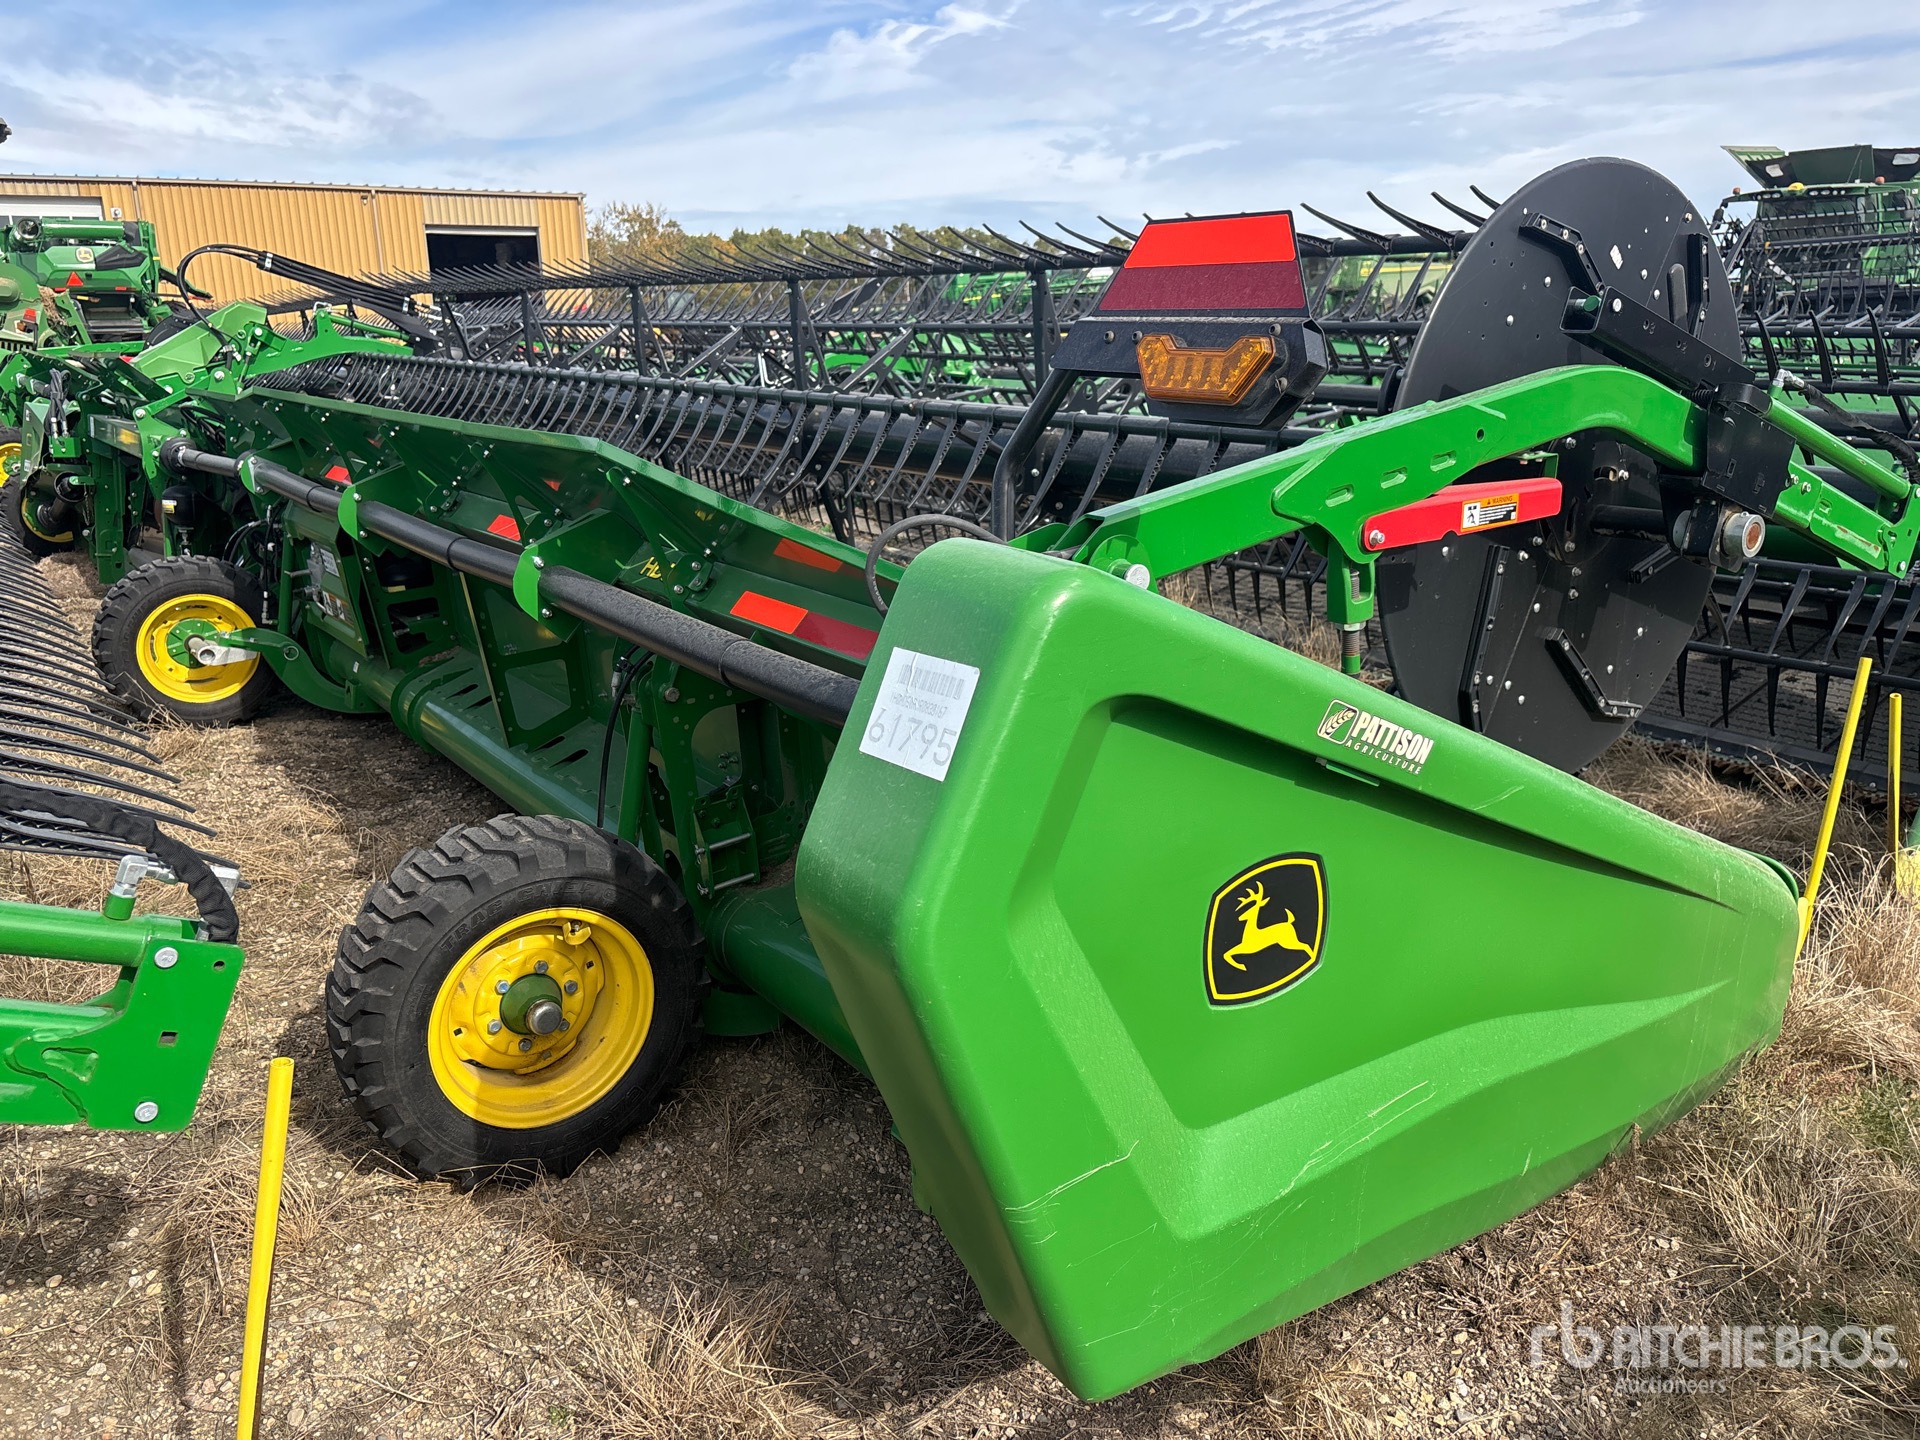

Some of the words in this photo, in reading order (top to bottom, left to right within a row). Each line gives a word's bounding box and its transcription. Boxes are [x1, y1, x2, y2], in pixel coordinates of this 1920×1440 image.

[1492, 496, 1513, 504] WARNING
[868, 707, 958, 767] 61795
[1345, 739, 1422, 775] AGRICULTURE
[1351, 711, 1435, 764] PATTISON
[441, 901, 503, 951] TRAC
[518, 881, 595, 901] CHIEF
